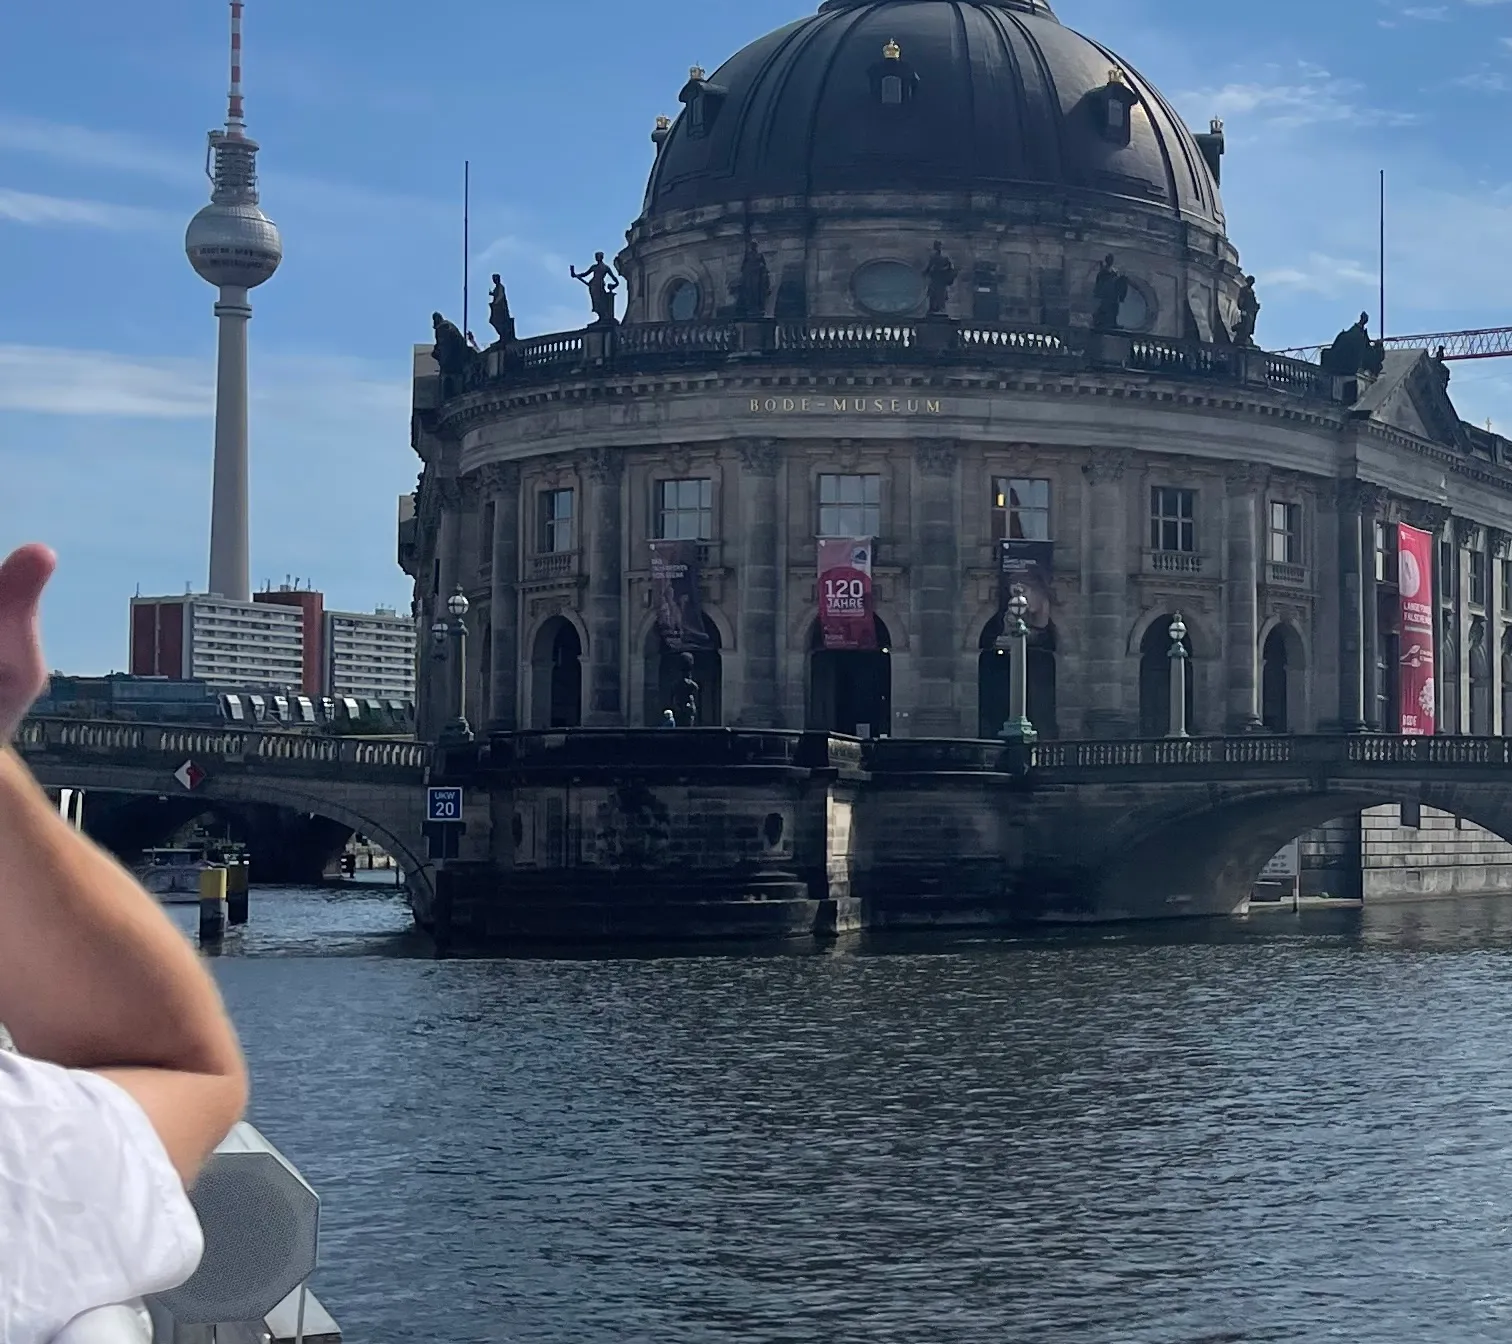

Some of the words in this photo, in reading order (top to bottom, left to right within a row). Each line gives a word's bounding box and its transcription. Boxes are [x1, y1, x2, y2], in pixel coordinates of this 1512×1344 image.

[825, 580, 863, 598] 120
[827, 598, 864, 609] JAHRE
[436, 802, 454, 816] 20
